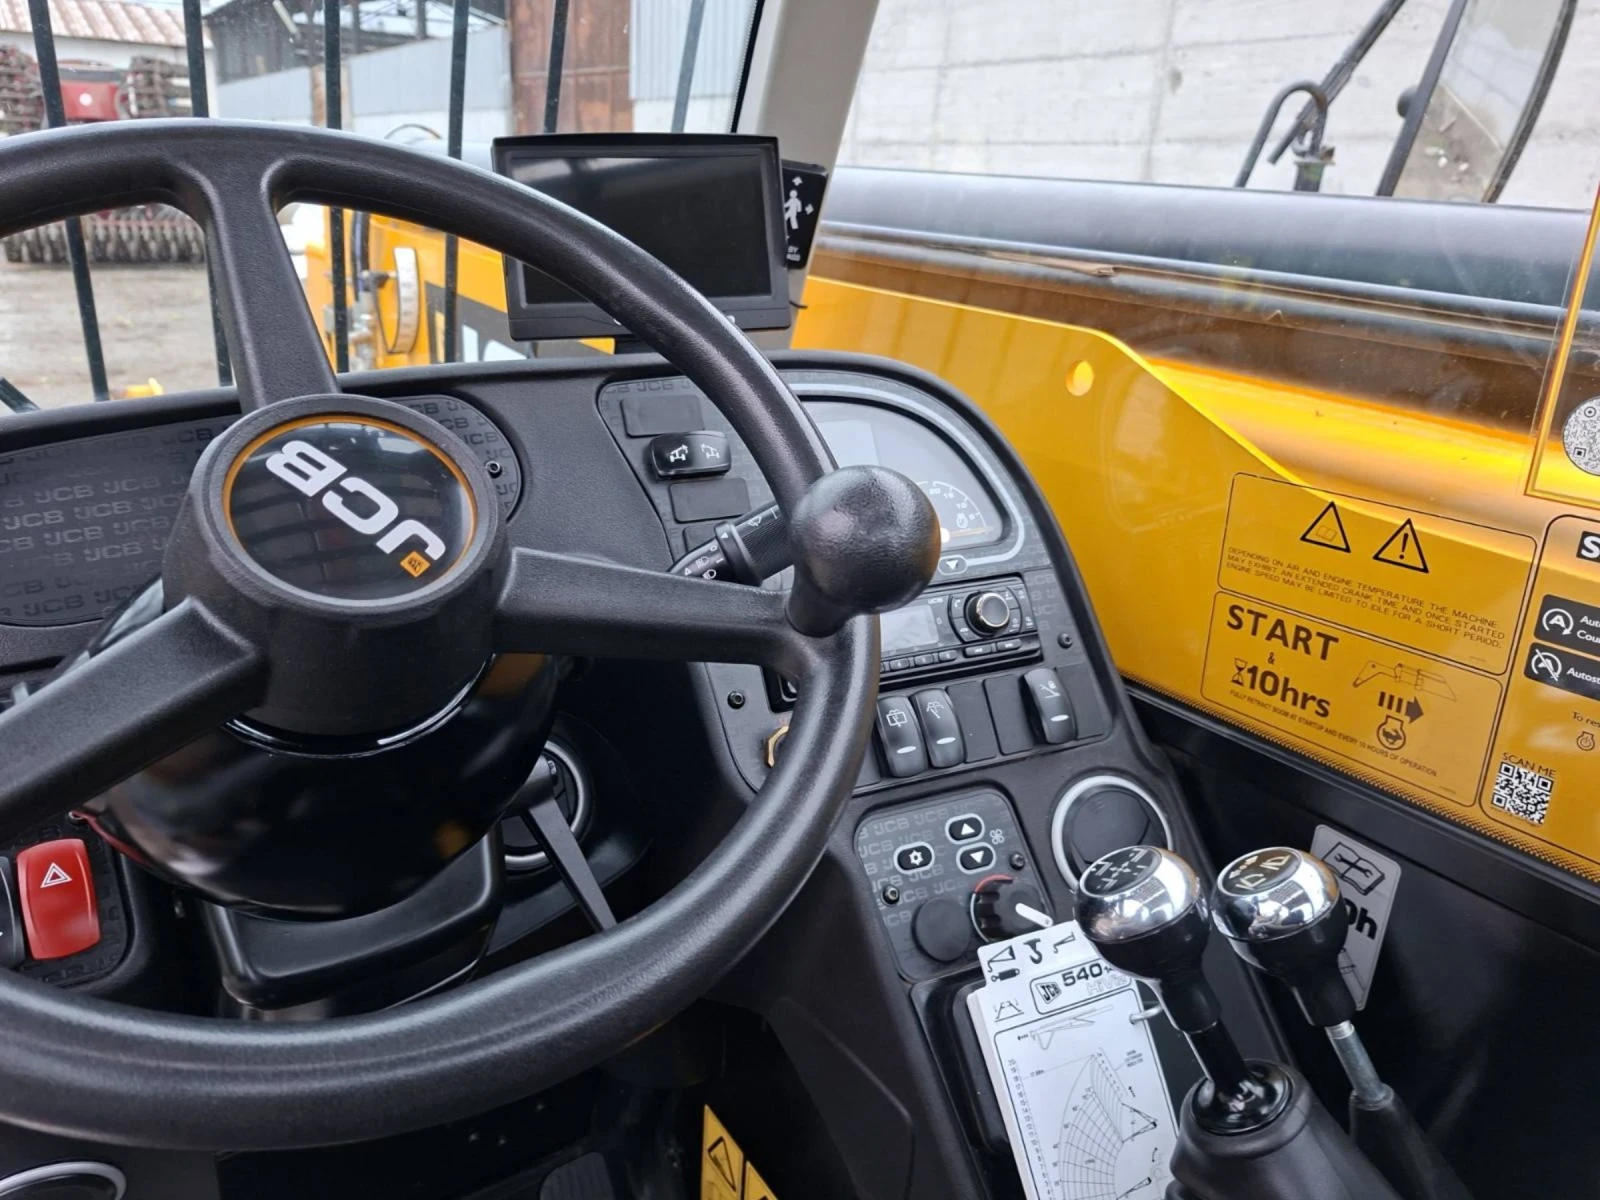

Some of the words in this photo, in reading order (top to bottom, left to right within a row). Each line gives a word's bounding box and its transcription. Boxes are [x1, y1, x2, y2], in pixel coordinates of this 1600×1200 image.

[409, 402, 440, 414] CB
[440, 417, 469, 430] CB
[34, 484, 95, 504] JCB
[265, 440, 447, 561] JCB
[3, 510, 64, 531] JCB
[74, 501, 132, 520] JCB
[44, 526, 104, 546] JCB
[84, 541, 142, 562] JCB
[1255, 570, 1280, 582] SPEED
[1282, 578, 1302, 588] MAY
[1318, 588, 1352, 603] LIMITED
[1356, 600, 1368, 608] TO
[1393, 610, 1411, 622] FOR
[1426, 622, 1458, 635] SHORT
[1464, 632, 1502, 648] PERIOD.
[1281, 570, 1292, 578] AN
[1296, 574, 1339, 591] EXTENDED
[1342, 588, 1372, 600] CRANK
[1377, 596, 1397, 608] TIME
[1402, 604, 1422, 616] AND
[1426, 611, 1450, 623] ONCE
[1455, 620, 1505, 640] STARTED
[1303, 568, 1320, 577] AND
[1324, 573, 1352, 586] ENGINE
[1357, 582, 1424, 607] TEMPERATURE
[1430, 604, 1448, 614] THE
[1452, 610, 1498, 628] MACHINE
[1226, 603, 1339, 662] START
[1268, 651, 1275, 665] &
[1246, 664, 1331, 718] 10hrs
[1338, 732, 1358, 744] EVERY
[1366, 744, 1388, 758] HOURS
[1390, 752, 1398, 760] OF
[1400, 757, 1437, 776] OPERATION
[1502, 752, 1535, 770] SCAN
[1538, 765, 1556, 778] ME
[1041, 984, 1062, 1002] JCB
